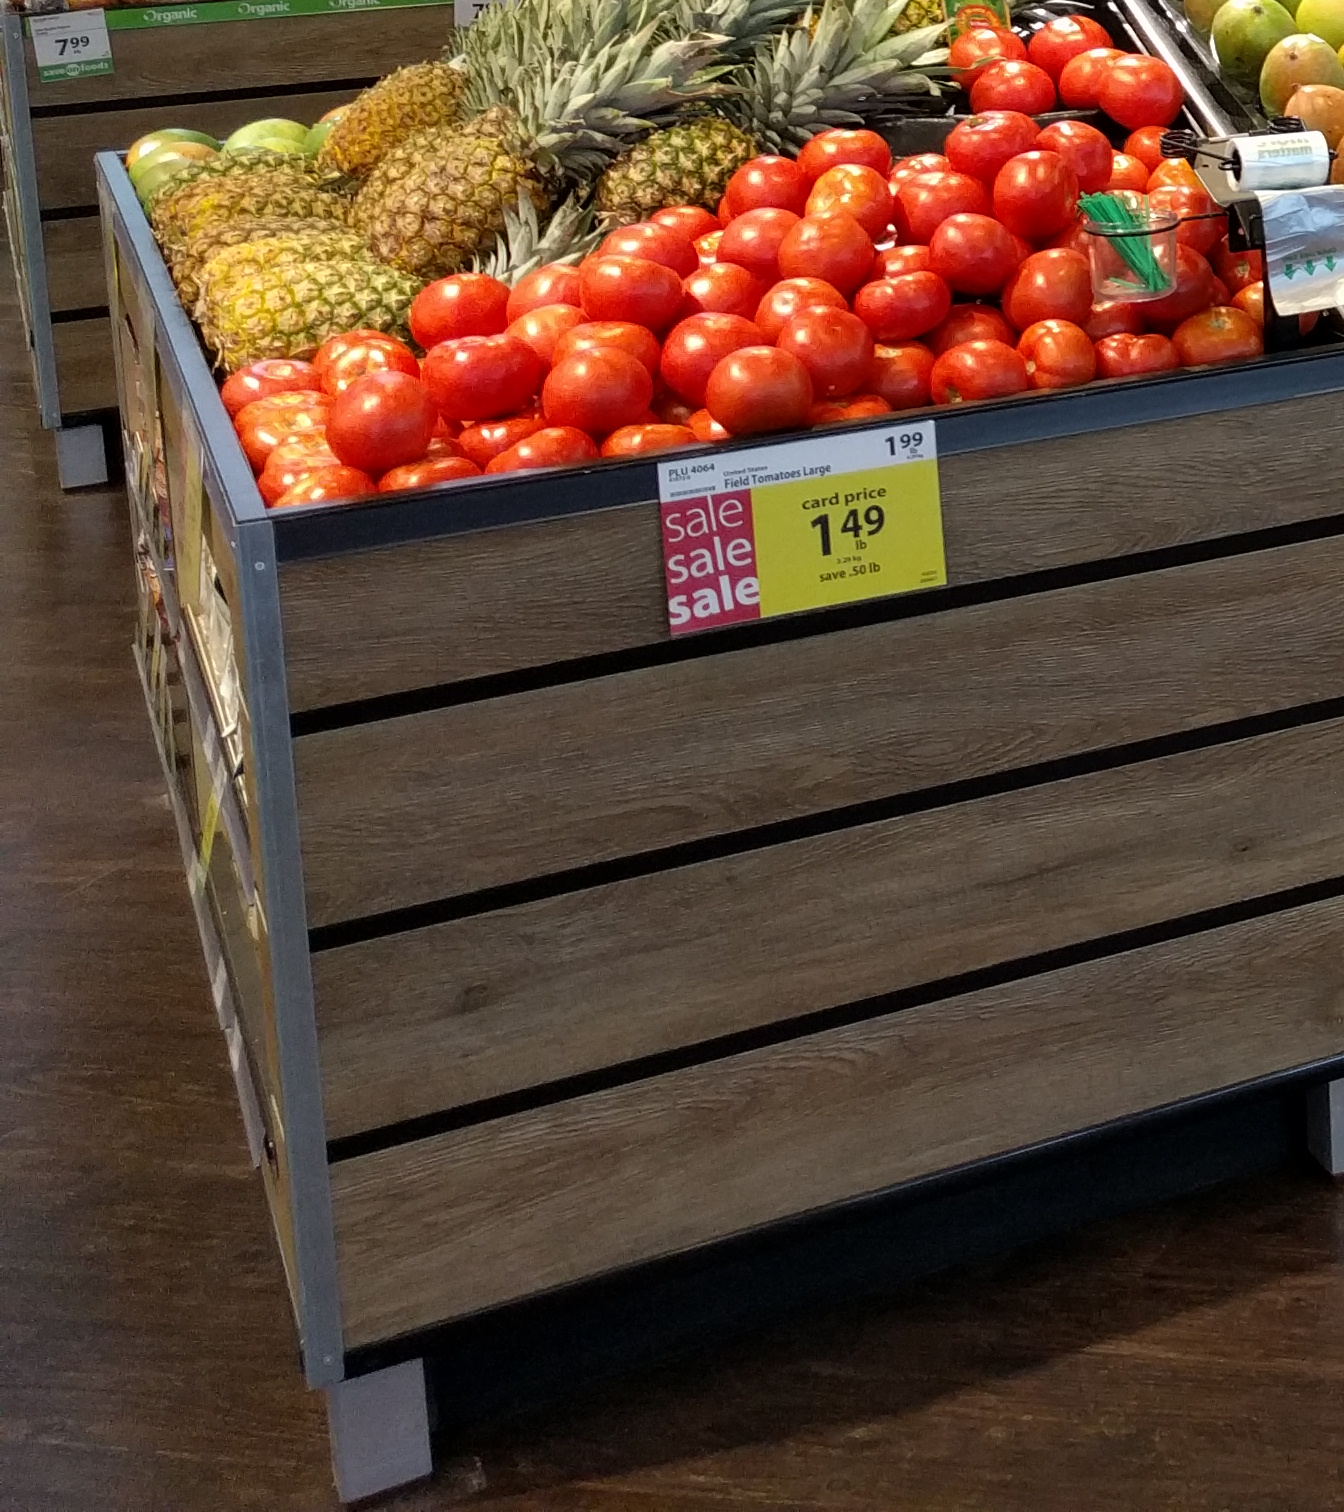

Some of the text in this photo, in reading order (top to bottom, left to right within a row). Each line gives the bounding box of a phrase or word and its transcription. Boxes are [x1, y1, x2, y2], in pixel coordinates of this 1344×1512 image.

[143, 8, 198, 22] Organic
[237, 0, 291, 17] Organic
[724, 463, 831, 489] Field Tomatoes Large
[801, 486, 887, 511] card price
[666, 495, 743, 543] sale
[668, 537, 752, 584] sale
[819, 568, 847, 582] save
[669, 574, 761, 625] sale
